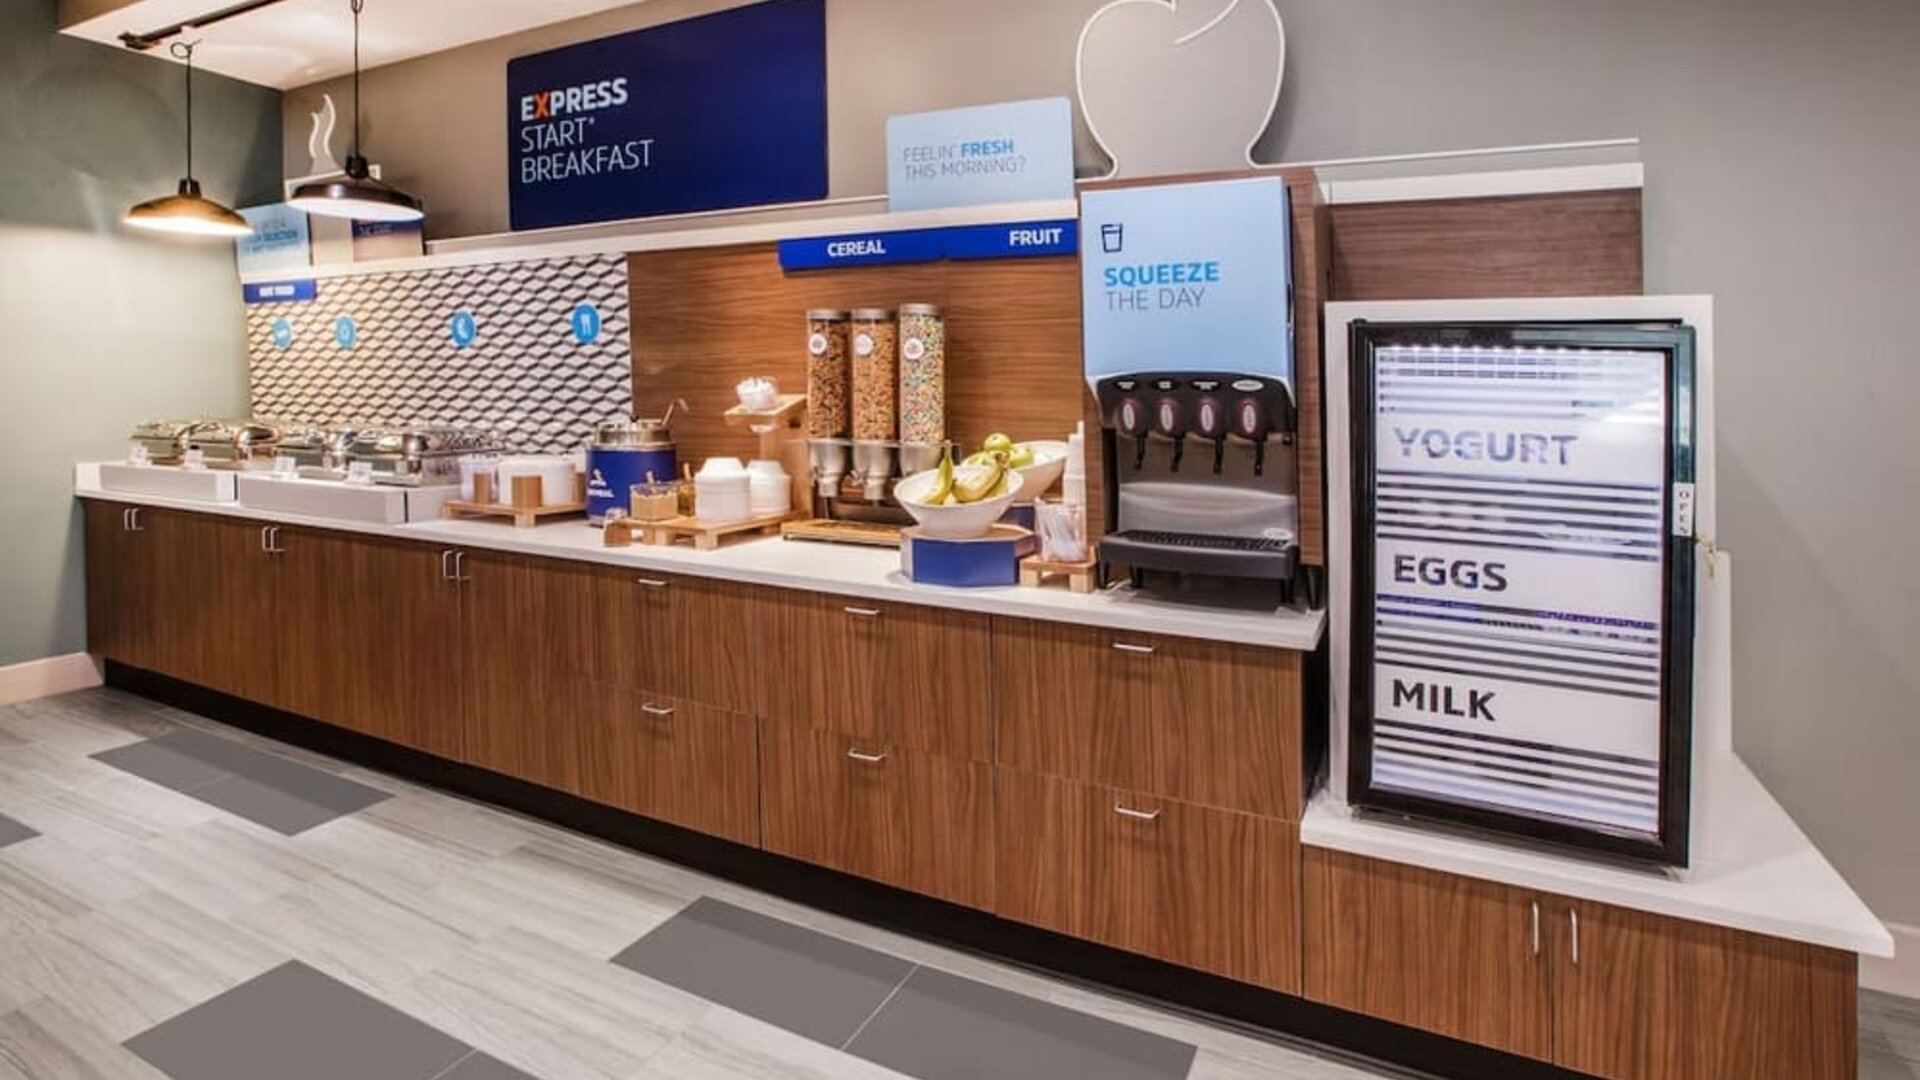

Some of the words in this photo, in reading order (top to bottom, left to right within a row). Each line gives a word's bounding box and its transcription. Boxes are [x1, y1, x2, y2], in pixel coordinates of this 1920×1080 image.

[521, 78, 628, 121] EXPRESS
[521, 139, 654, 183] BREAKFAST
[961, 139, 1014, 157] FRESH
[905, 163, 937, 178] THIS
[942, 155, 1026, 176] MORNING?
[827, 240, 886, 257] CEREAL
[1010, 228, 1062, 246] FRUIT
[1104, 261, 1219, 287] SQUEEZE
[1106, 289, 1149, 310] THE
[1159, 287, 1205, 309] DAY
[1393, 427, 1578, 465] YOGURT
[1394, 554, 1508, 592] EGGS
[1392, 679, 1496, 721] MILK
